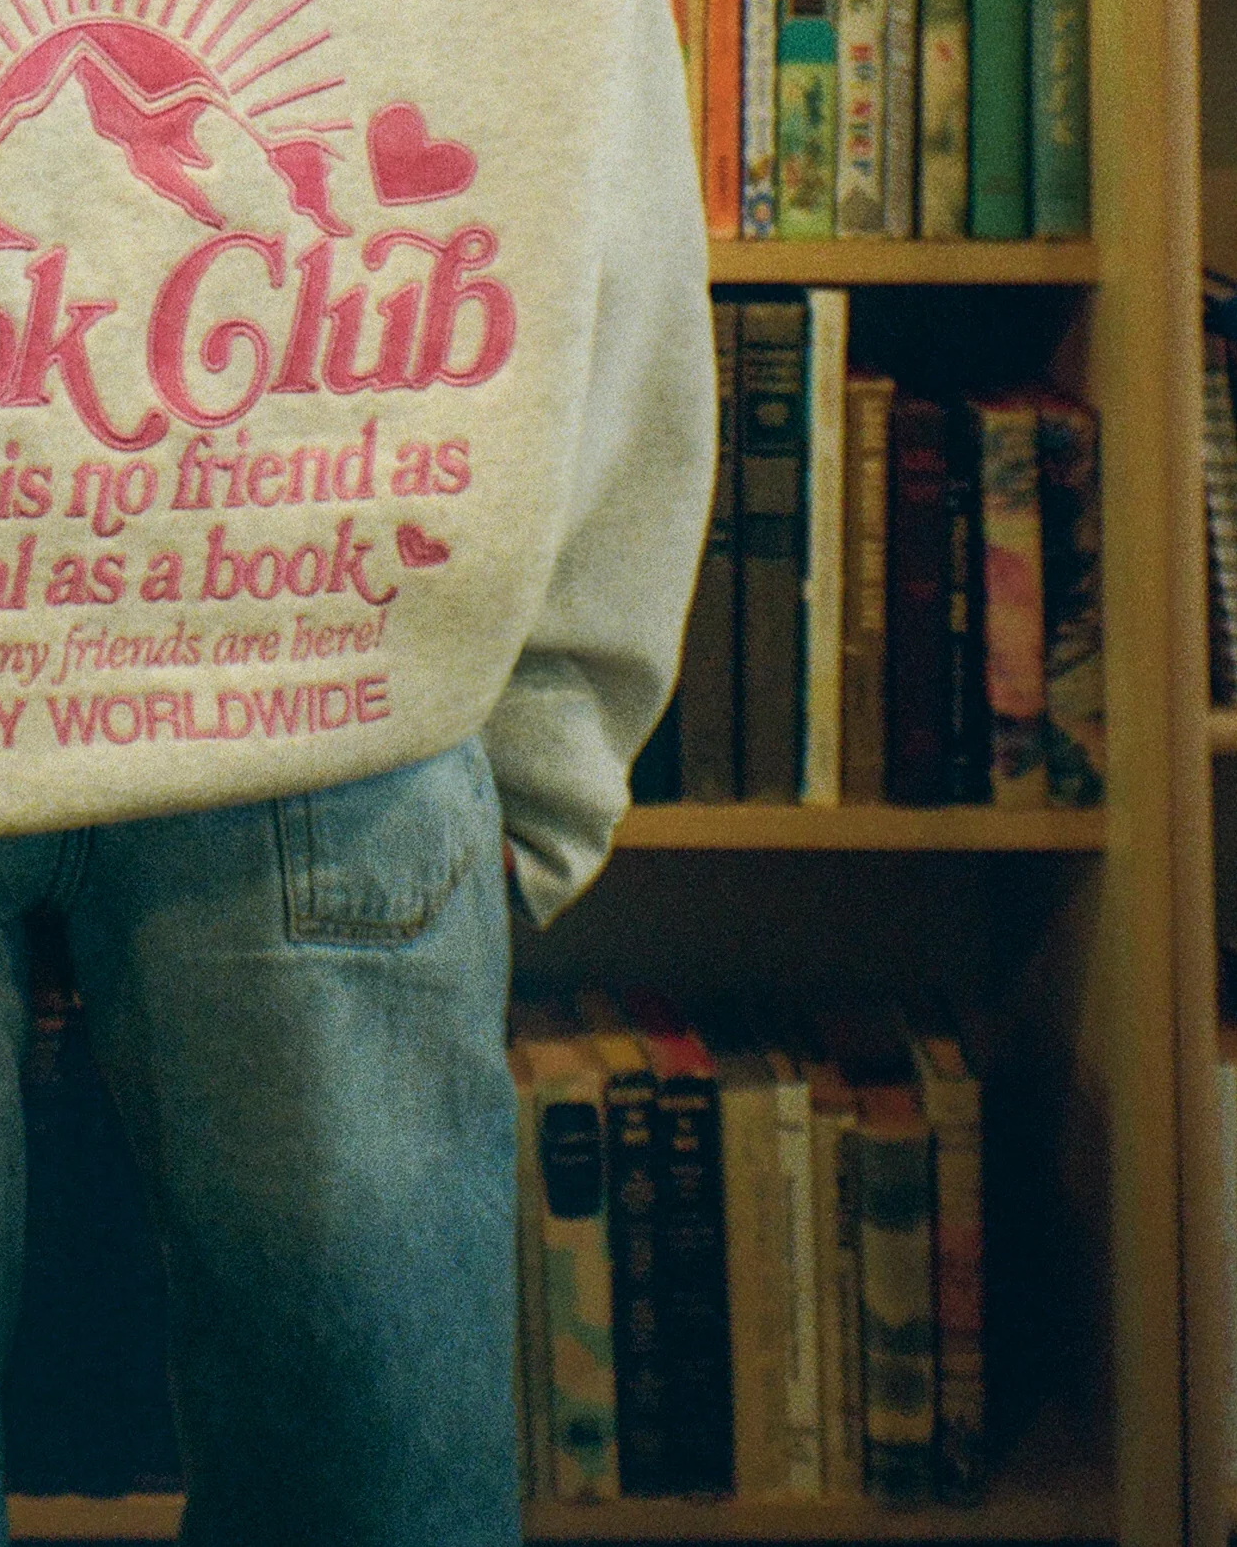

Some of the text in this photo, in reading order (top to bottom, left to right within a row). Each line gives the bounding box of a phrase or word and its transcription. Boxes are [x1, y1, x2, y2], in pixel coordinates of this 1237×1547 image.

[146, 224, 518, 430] Club
[64, 459, 159, 539] no
[169, 418, 379, 511] friend
[389, 440, 472, 498] as
[43, 553, 127, 608] as
[138, 551, 184, 603] a
[200, 517, 399, 606] book
[52, 619, 202, 687] friends
[212, 628, 282, 668] are
[290, 609, 388, 657] here!
[44, 673, 393, 748] WORLDWIDE
